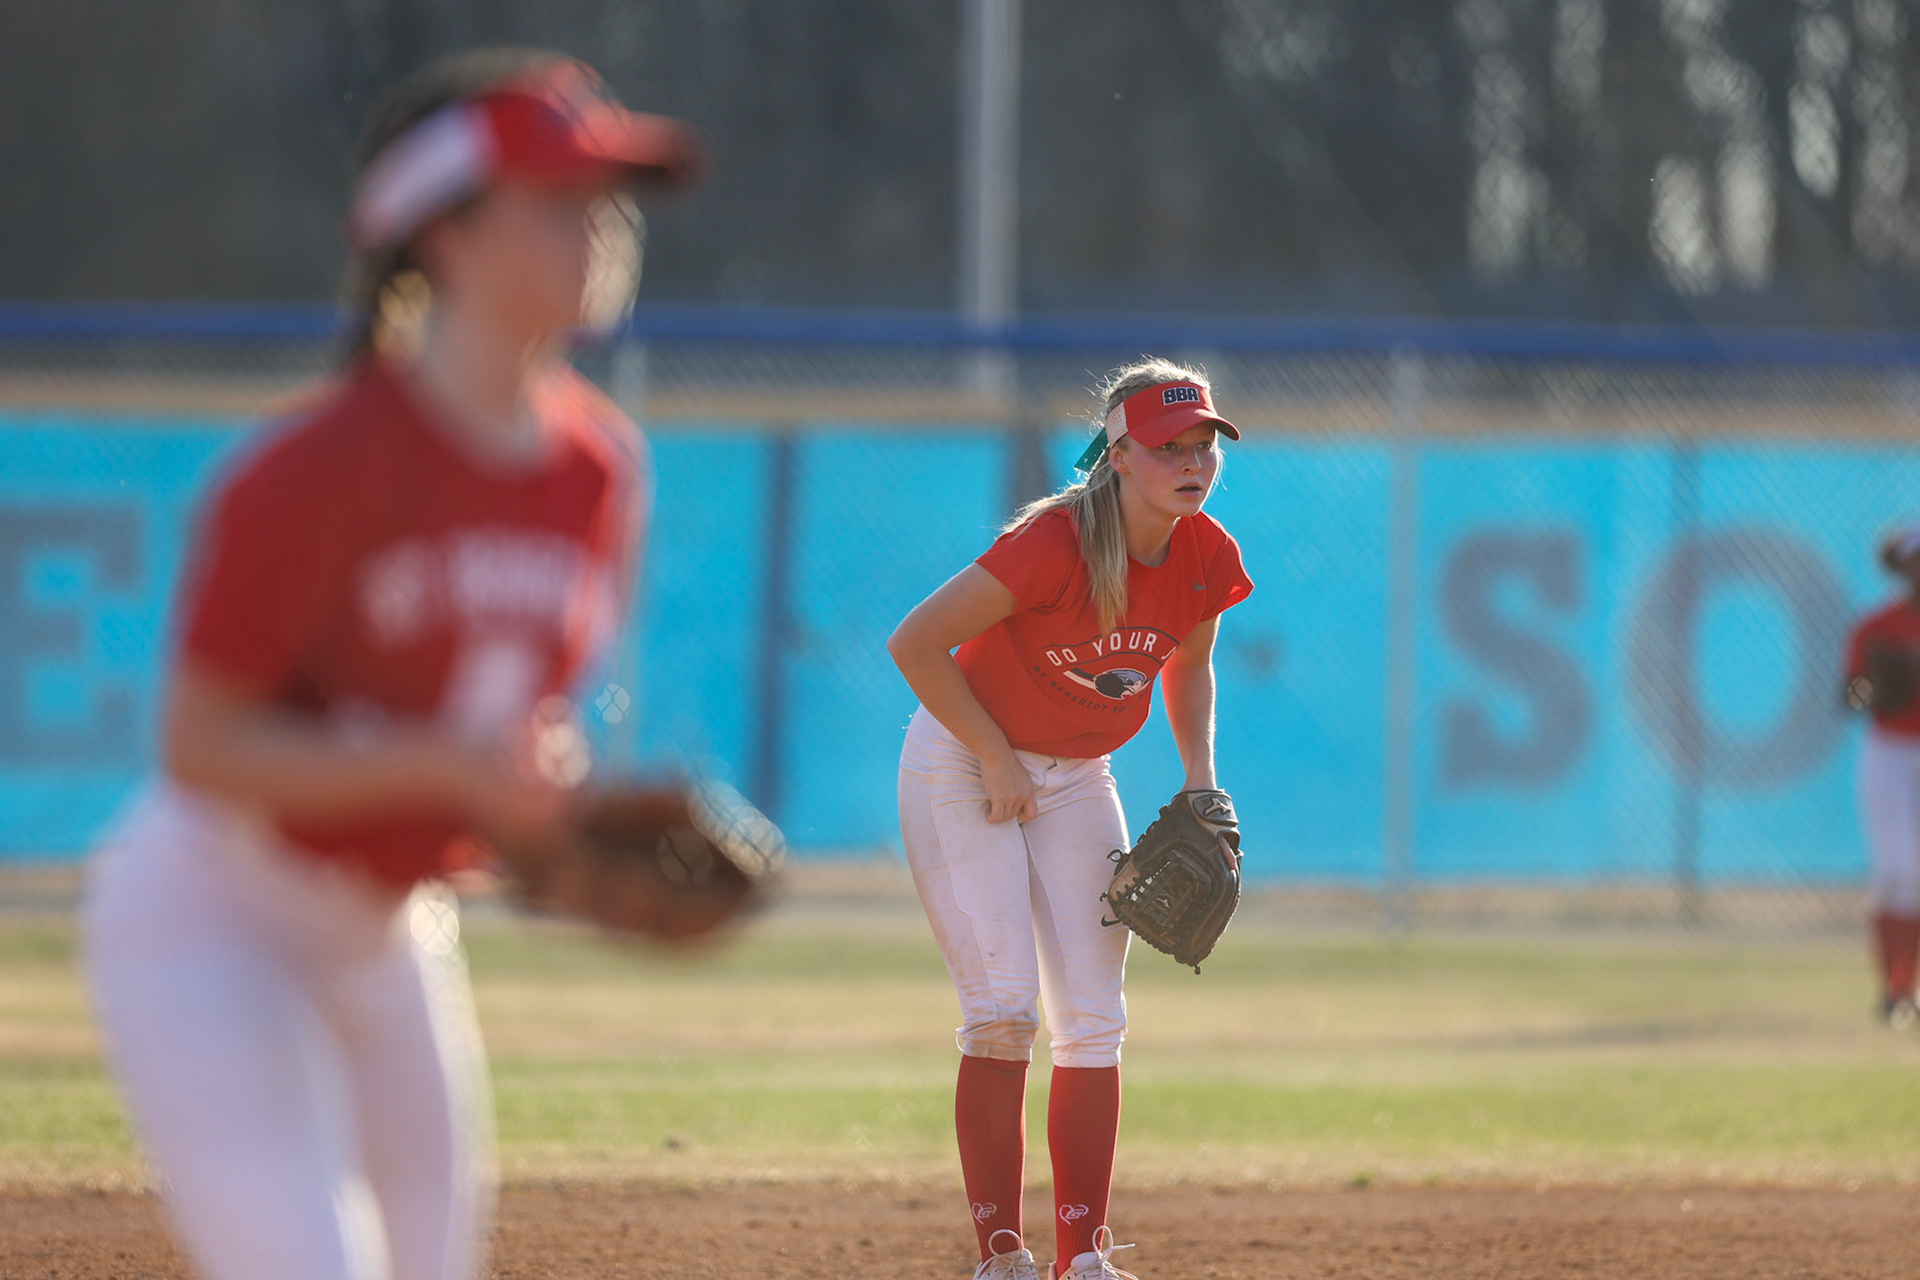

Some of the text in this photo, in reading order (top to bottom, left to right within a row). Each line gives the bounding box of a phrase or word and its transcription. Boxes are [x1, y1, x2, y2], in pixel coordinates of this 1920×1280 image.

[1045, 631, 1177, 666] DO YOUR J
